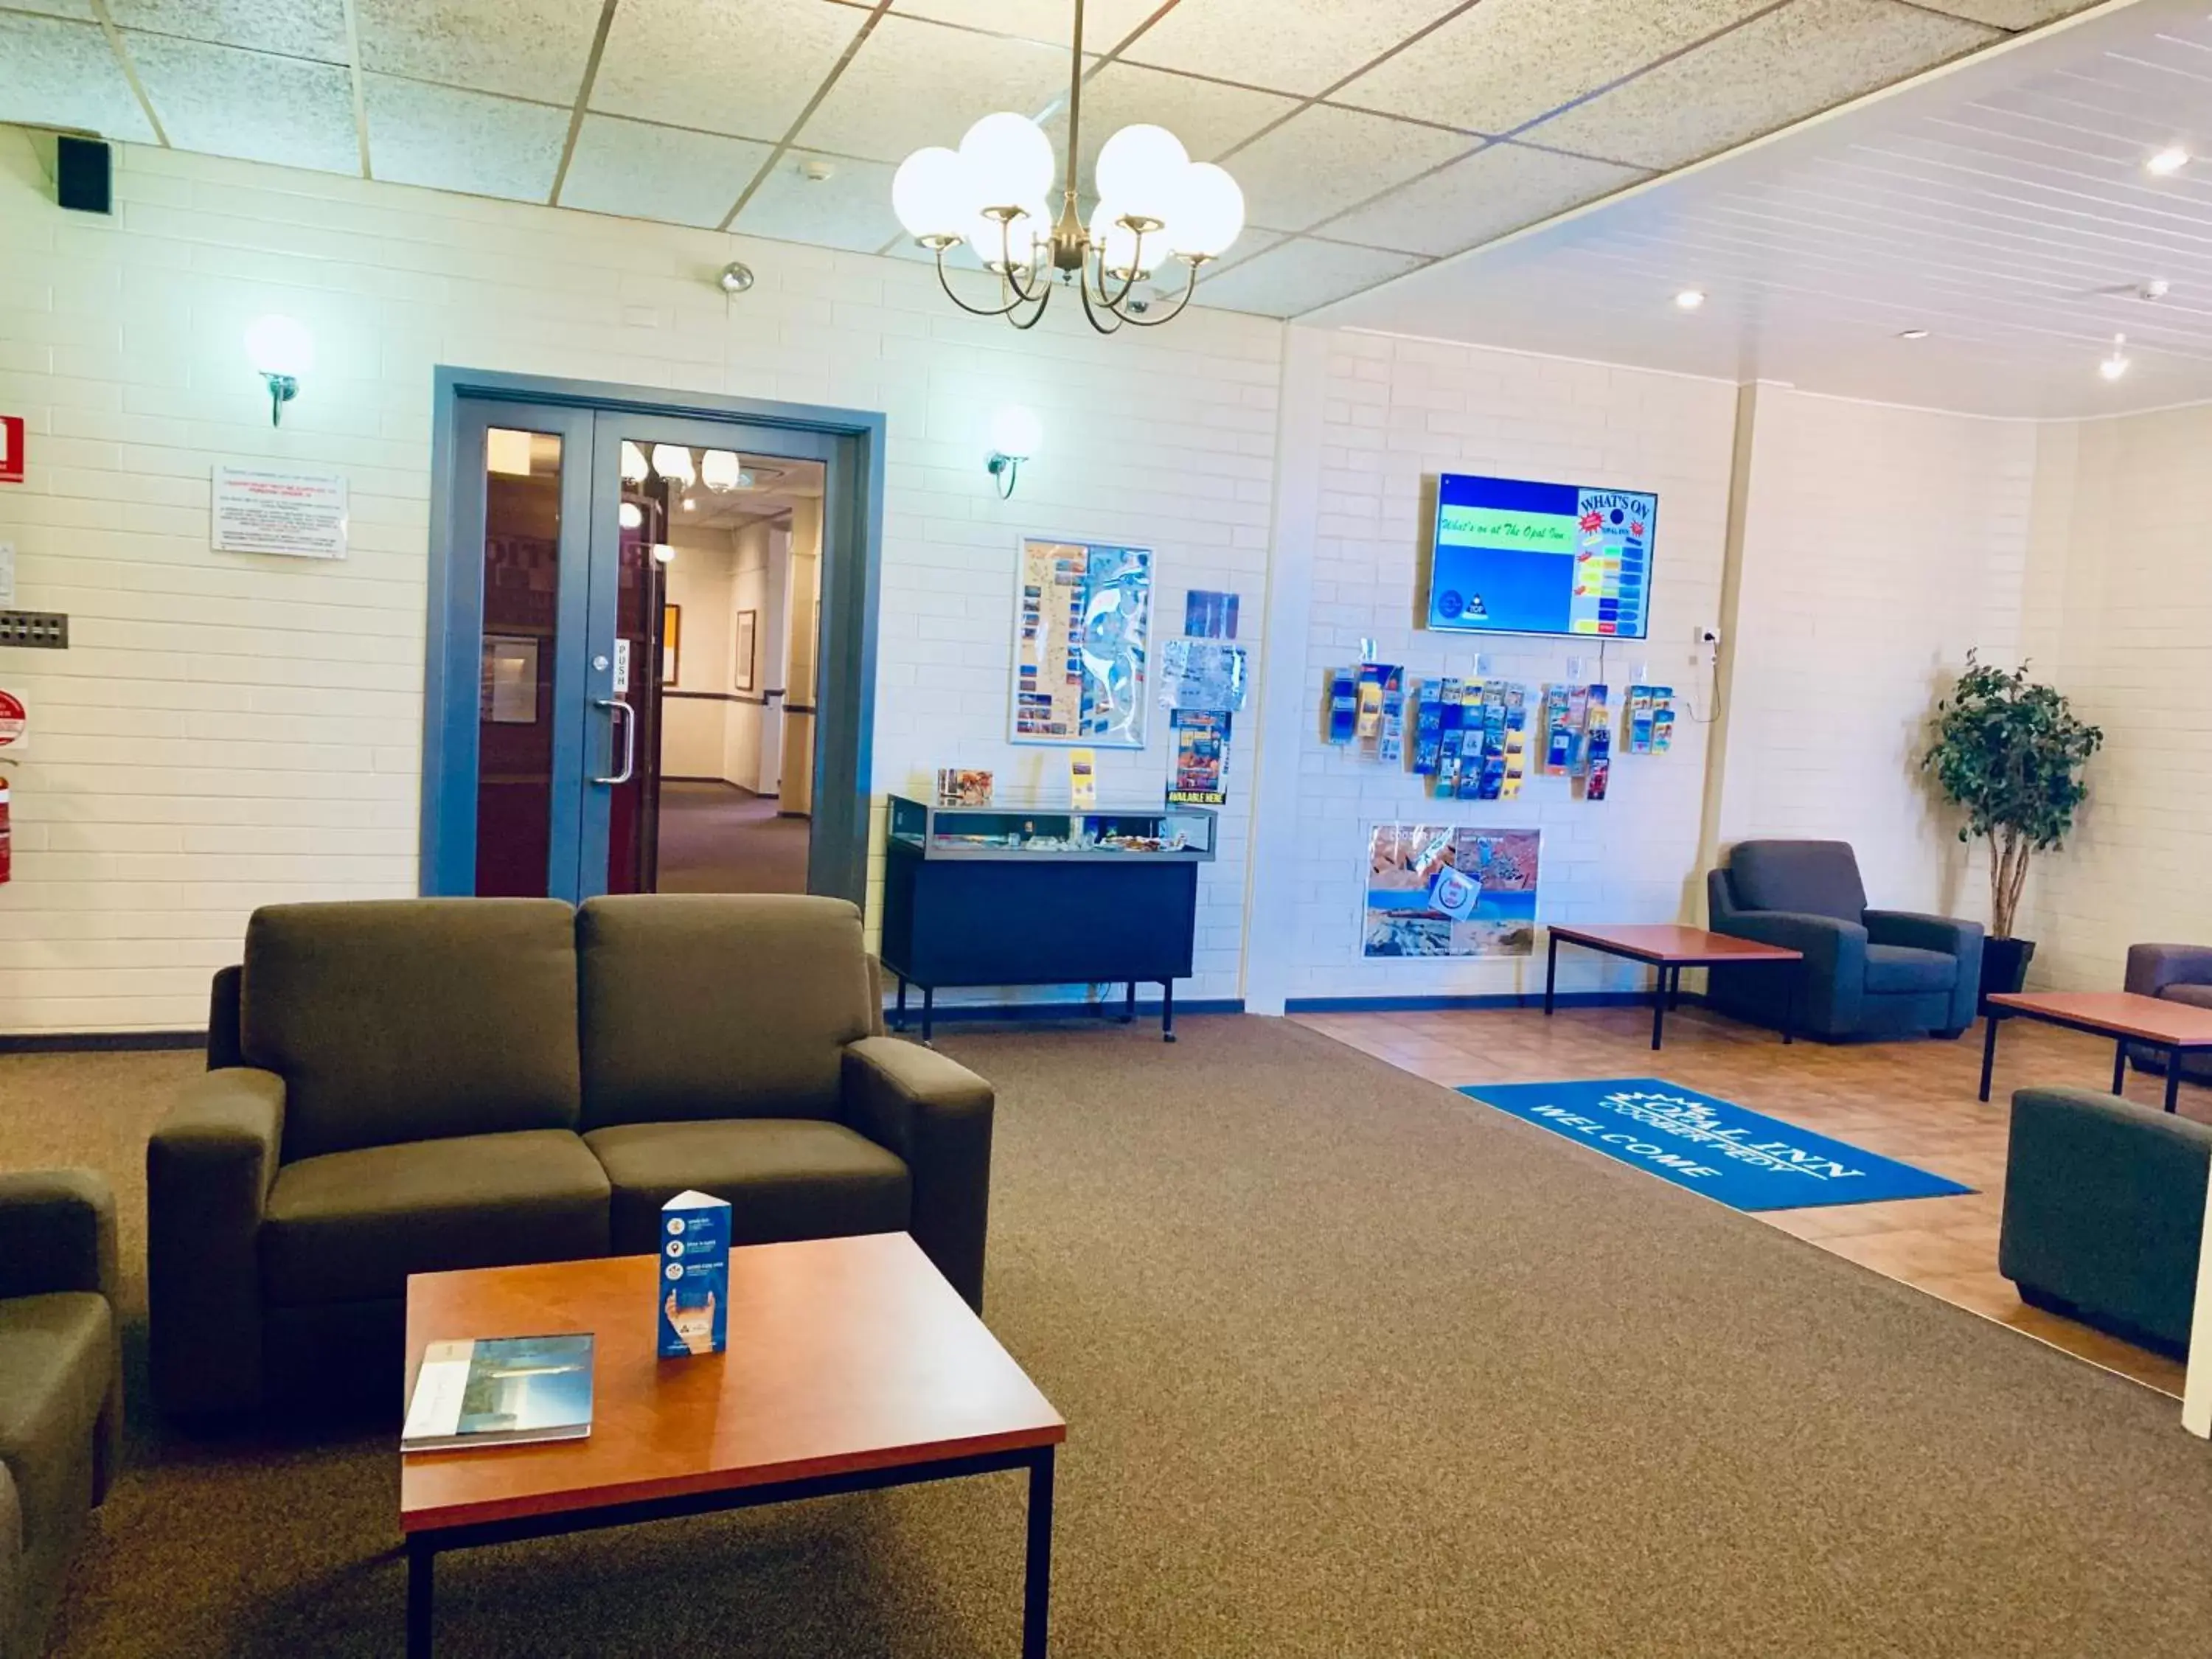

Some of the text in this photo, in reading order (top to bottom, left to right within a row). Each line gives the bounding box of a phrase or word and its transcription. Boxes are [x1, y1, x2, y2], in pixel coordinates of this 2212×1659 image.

[1580, 495, 1630, 518] WHAT'S
[617, 645, 626, 685] PUSH
[1169, 791, 1205, 803] AVAILABLE
[1530, 1105, 1723, 1178] WELCOME
[1598, 1101, 1798, 1172] COOBER PEDY
[1644, 1102, 1867, 1178] OPAL INN
